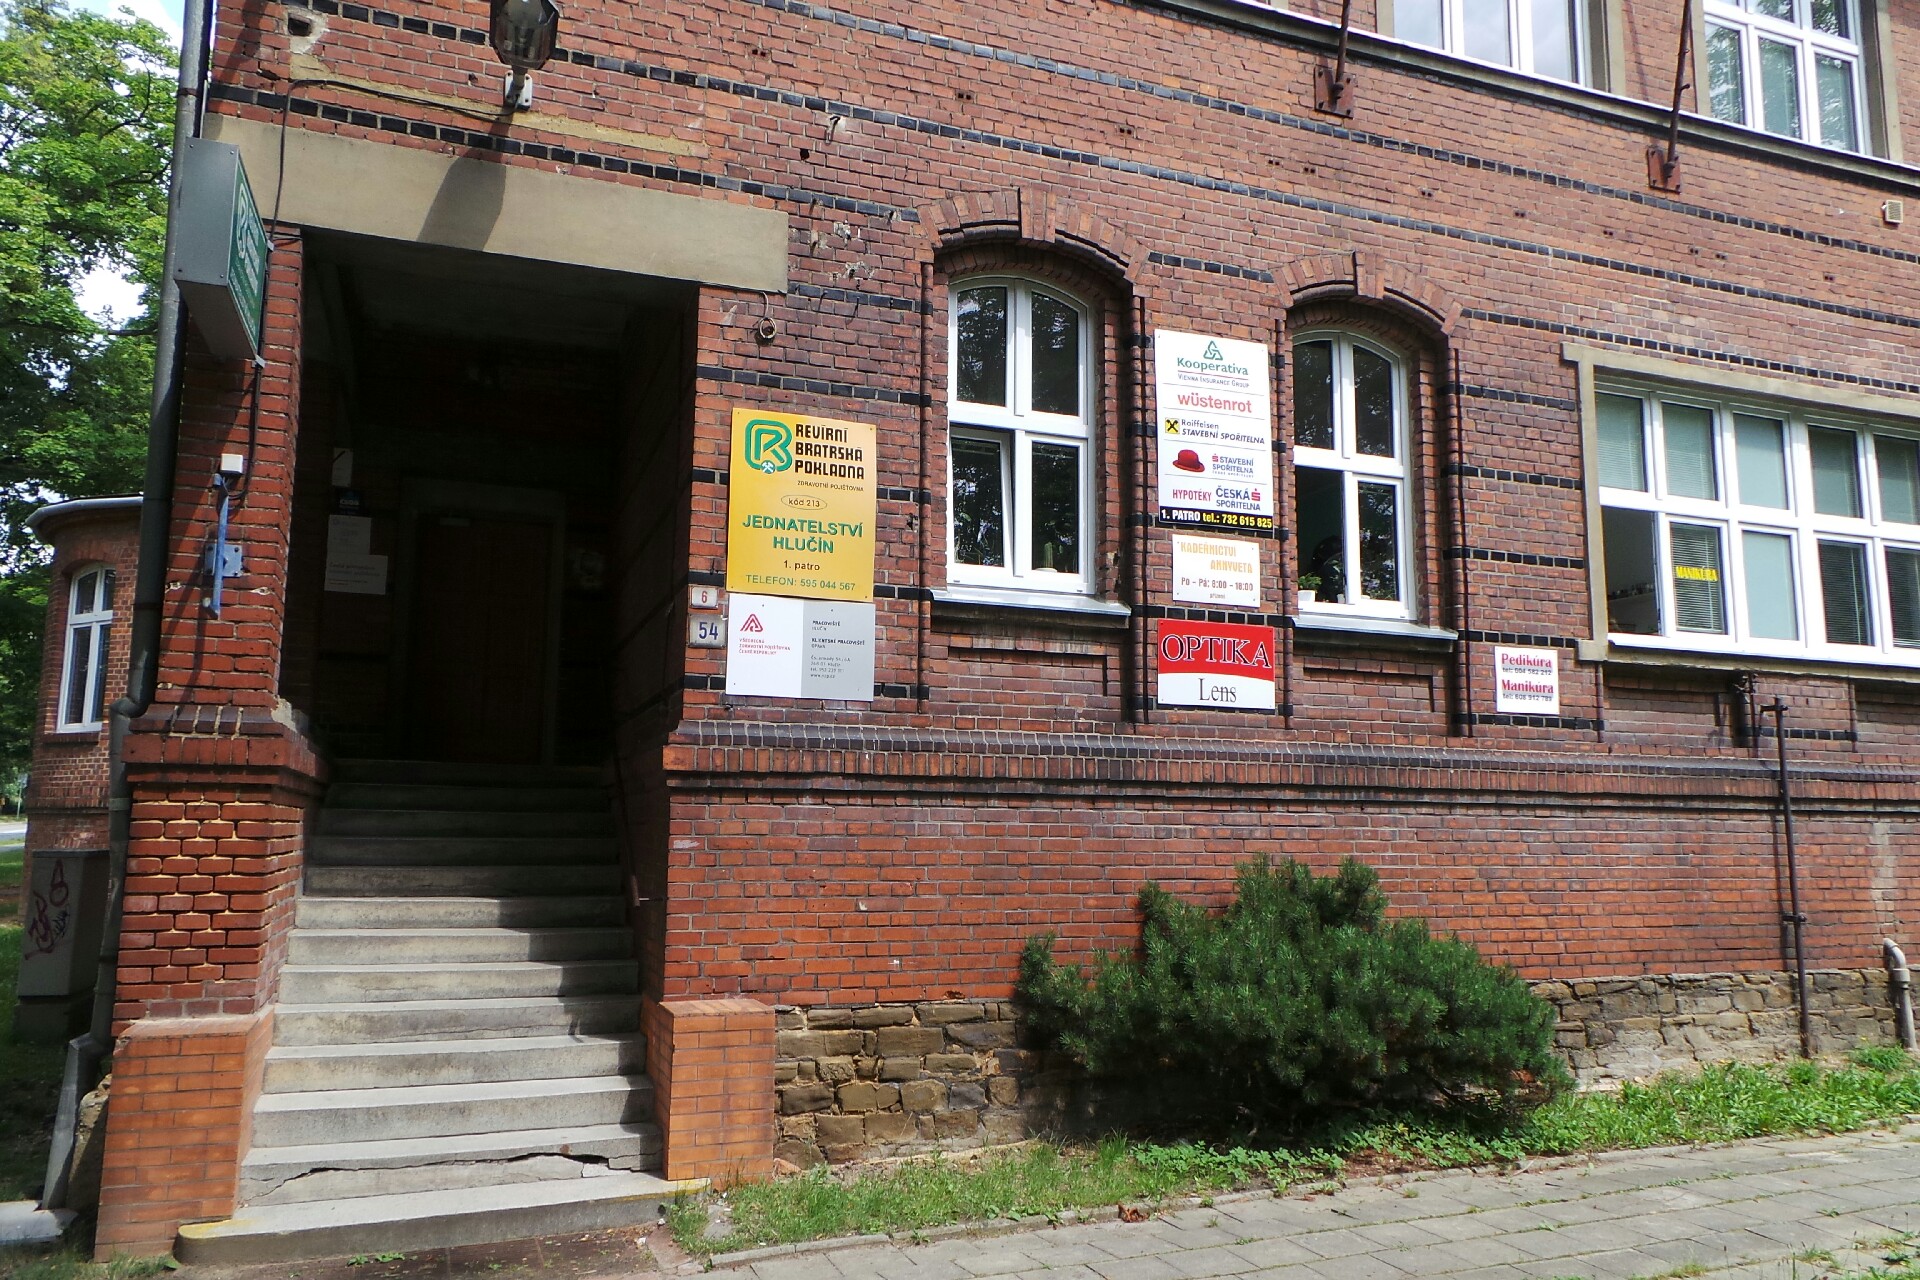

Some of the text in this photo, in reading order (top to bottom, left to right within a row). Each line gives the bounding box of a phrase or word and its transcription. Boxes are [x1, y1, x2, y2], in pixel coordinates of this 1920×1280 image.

[1177, 358, 1248, 375] Kooperativa
[1178, 392, 1251, 413] wüstenrot
[1182, 419, 1219, 429] Raiffeisen
[796, 424, 848, 443] REVÍRNÍ
[1182, 428, 1264, 444] STAVEBNÍ SPOŘITELNA
[796, 442, 863, 462] BRATRSKÁ
[1212, 462, 1253, 474] SPOŘITELNA
[1220, 456, 1254, 466] STAVEBNÍ
[795, 460, 864, 480] POKLADNA
[797, 480, 828, 489] ZDRAVOTNÍ
[1173, 485, 1250, 502] HYPOTÉKY ČESKÁ
[788, 498, 820, 508] kód 213
[1216, 498, 1260, 511] SPOŘITELNA
[742, 515, 863, 538] JEDNATELSTVÍ
[1162, 509, 1272, 528] 1. PATRO tel.: 732 615 825
[773, 534, 834, 554] HLUČÍN
[784, 561, 820, 572] 1. patro
[746, 575, 855, 591] TELEFON: 595 044 567
[1182, 577, 1190, 586] Po
[1212, 580, 1227, 588] 8:00
[1235, 582, 1253, 591] 18:00
[701, 591, 707, 604] 6
[699, 622, 718, 640] 54
[1161, 634, 1272, 668] OPTIKA
[1502, 653, 1552, 668] Pedikúra
[1198, 678, 1237, 703] Lens
[1502, 679, 1554, 693] Manikúra
